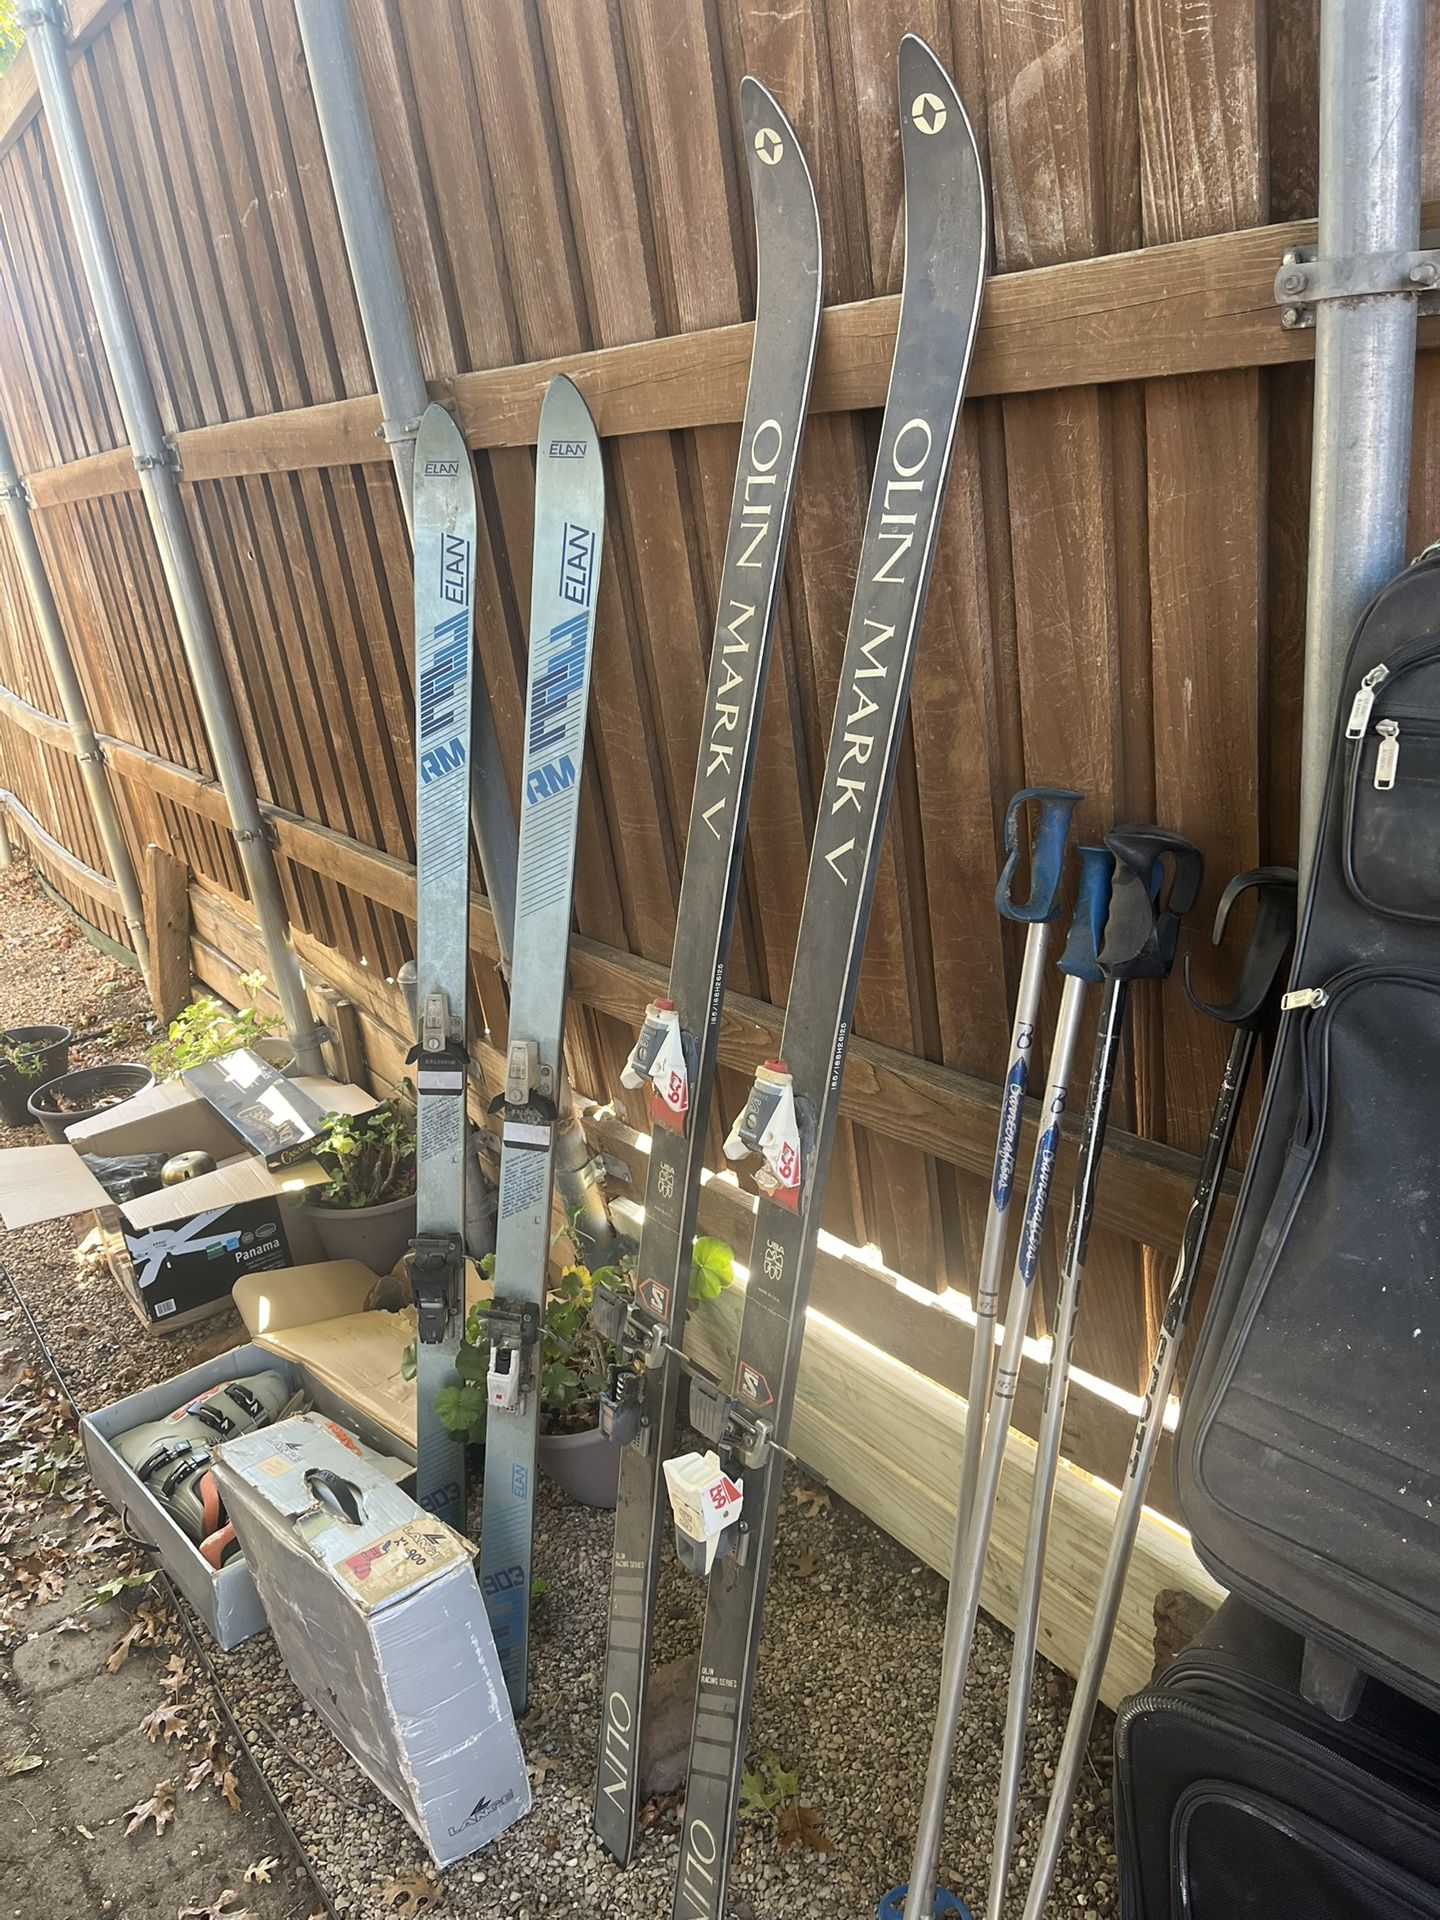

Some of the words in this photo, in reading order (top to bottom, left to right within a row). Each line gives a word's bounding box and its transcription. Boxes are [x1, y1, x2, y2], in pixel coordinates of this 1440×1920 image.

[424, 464, 459, 474] ELAN
[550, 444, 587, 456] ELAN
[735, 419, 783, 567] OLIN
[871, 418, 932, 584] OLIN
[445, 534, 465, 605] ELAN
[565, 524, 590, 604] ELAN
[706, 600, 756, 778] MARK
[831, 618, 896, 815] MARK
[420, 737, 466, 784] RM
[527, 755, 576, 805] RM
[701, 797, 727, 840] V
[824, 837, 856, 886] V
[234, 1239, 280, 1263] Panama
[515, 1464, 525, 1498] ELAN
[483, 1565, 525, 1596] 903
[602, 1691, 631, 1815] OLIN
